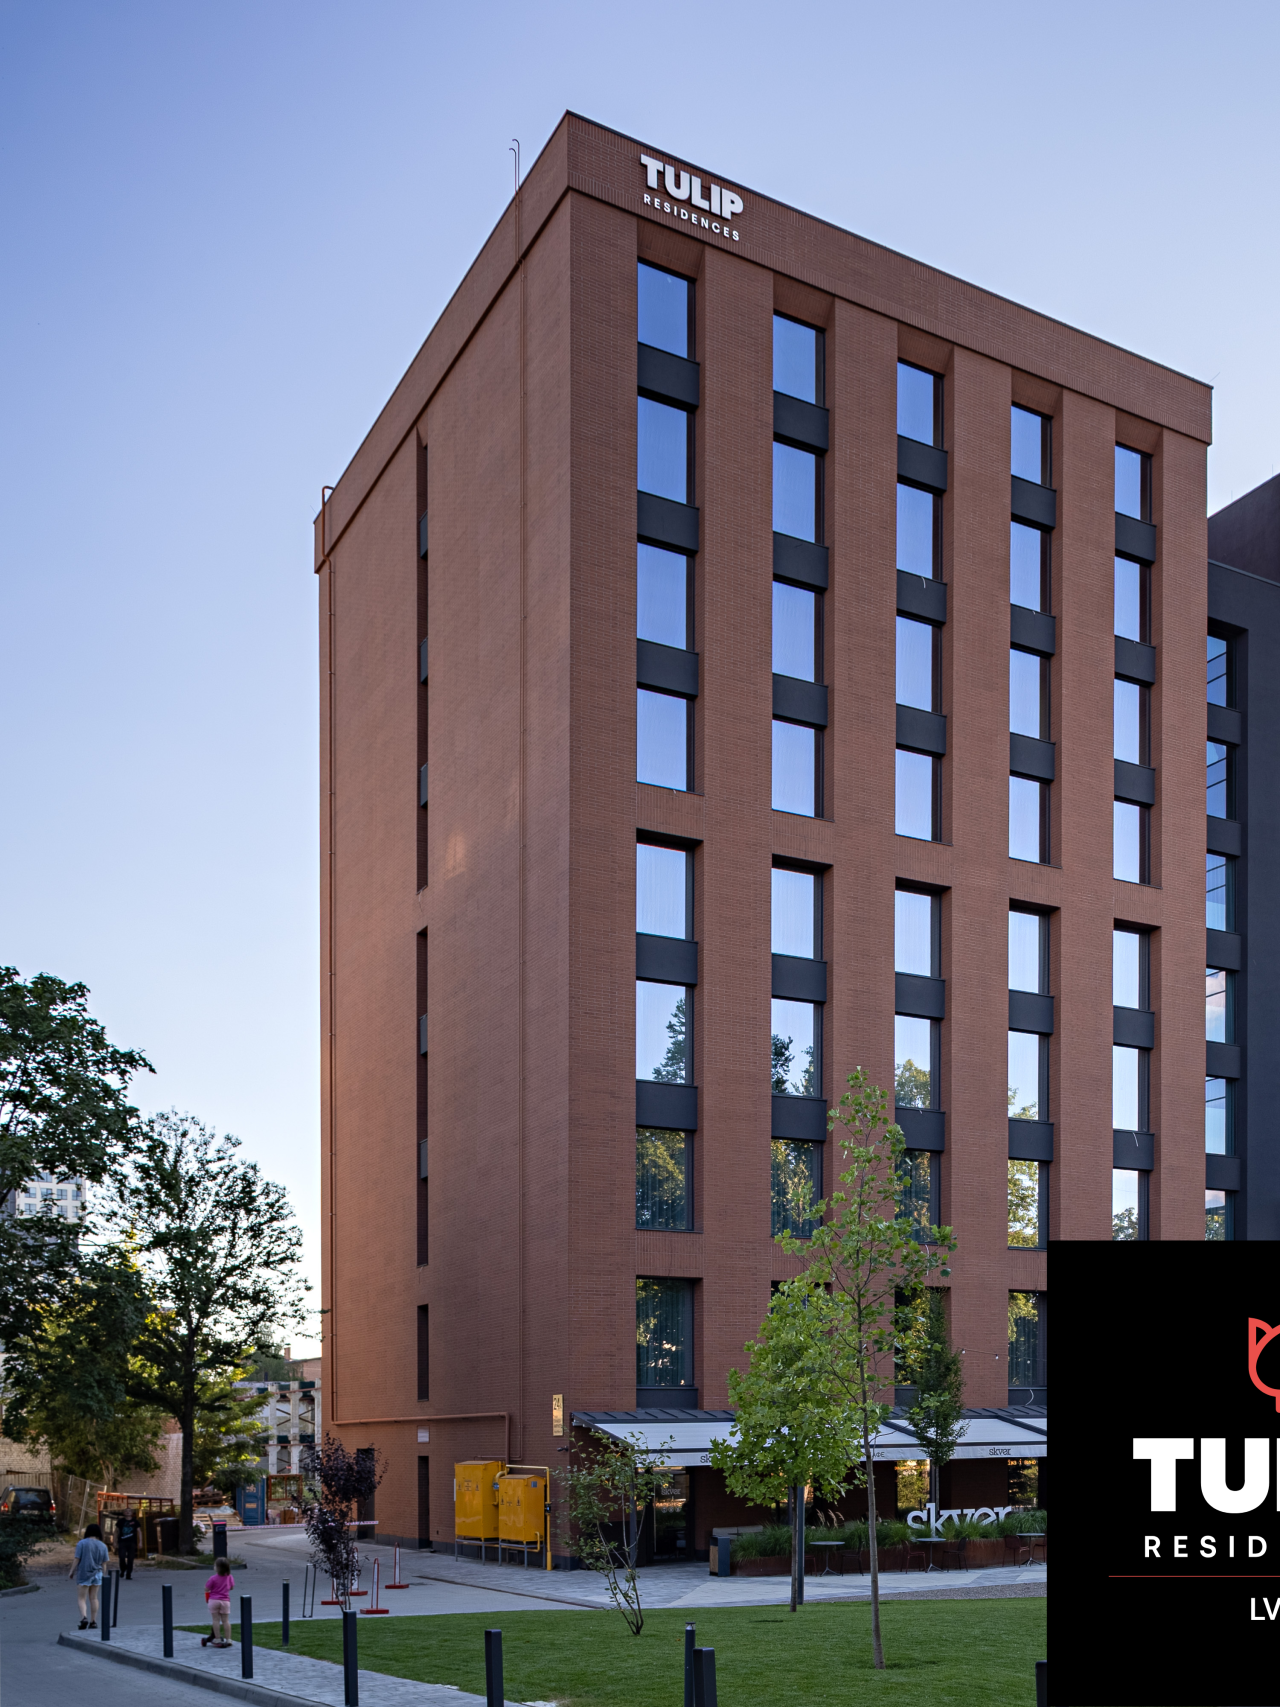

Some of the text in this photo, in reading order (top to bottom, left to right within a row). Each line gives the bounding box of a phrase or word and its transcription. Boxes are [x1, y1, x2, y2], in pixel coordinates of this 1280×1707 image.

[640, 153, 744, 220] TULIP
[643, 193, 740, 241] RESIDENCES
[988, 1447, 1011, 1456] skver
[906, 1502, 1012, 1538] skver
